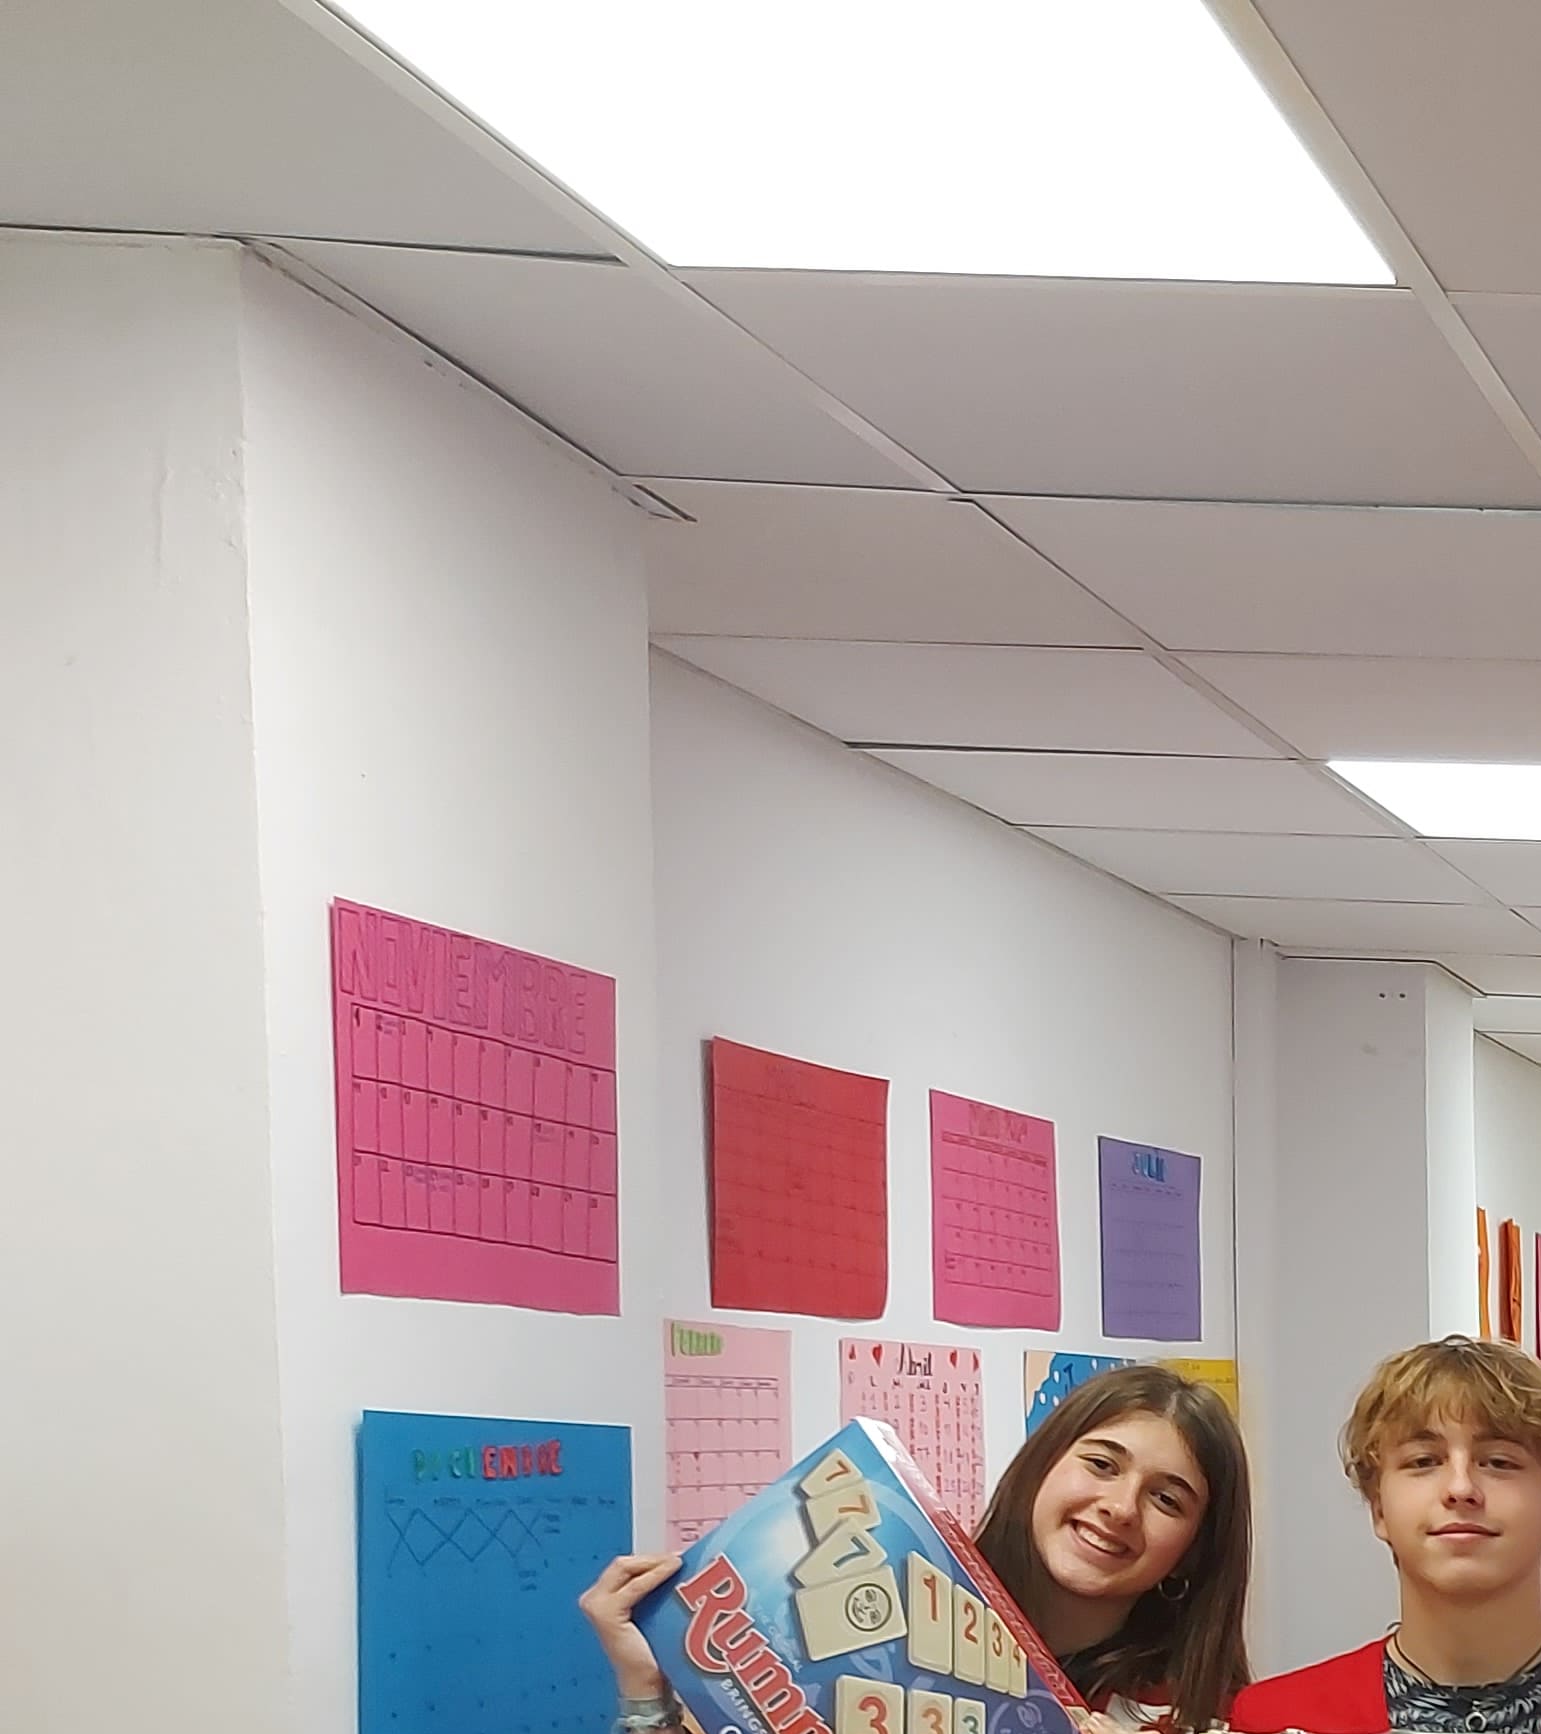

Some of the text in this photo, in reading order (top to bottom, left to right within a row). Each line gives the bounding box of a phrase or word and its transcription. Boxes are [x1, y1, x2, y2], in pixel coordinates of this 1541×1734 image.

[338, 907, 588, 1055] NOVIEMBRE
[923, 1573, 939, 1622] 1
[963, 1601, 979, 1645] 2
[991, 1621, 1003, 1658] 3
